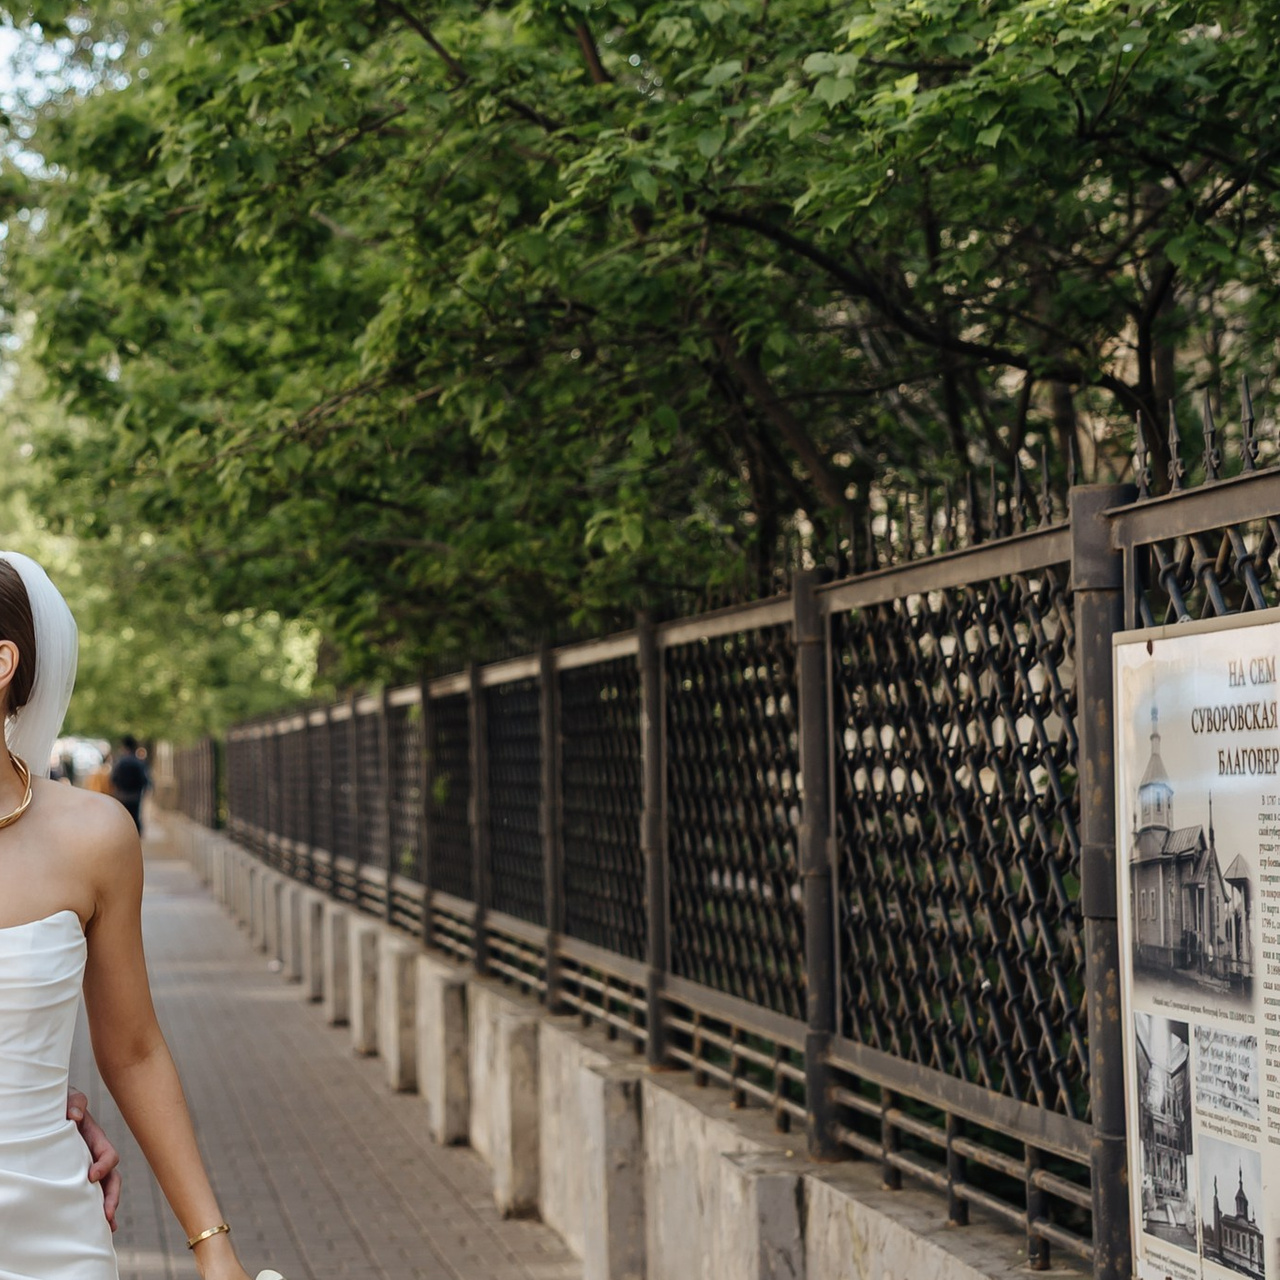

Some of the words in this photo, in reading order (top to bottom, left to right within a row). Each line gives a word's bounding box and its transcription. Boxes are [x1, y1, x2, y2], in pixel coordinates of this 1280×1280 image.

[1228, 658, 1246, 687] НА
[1249, 655, 1277, 685] СЕМ
[1191, 699, 1278, 734] СУВОРОВСКАЯ
[1218, 746, 1280, 776] БЛАГОВЕР
